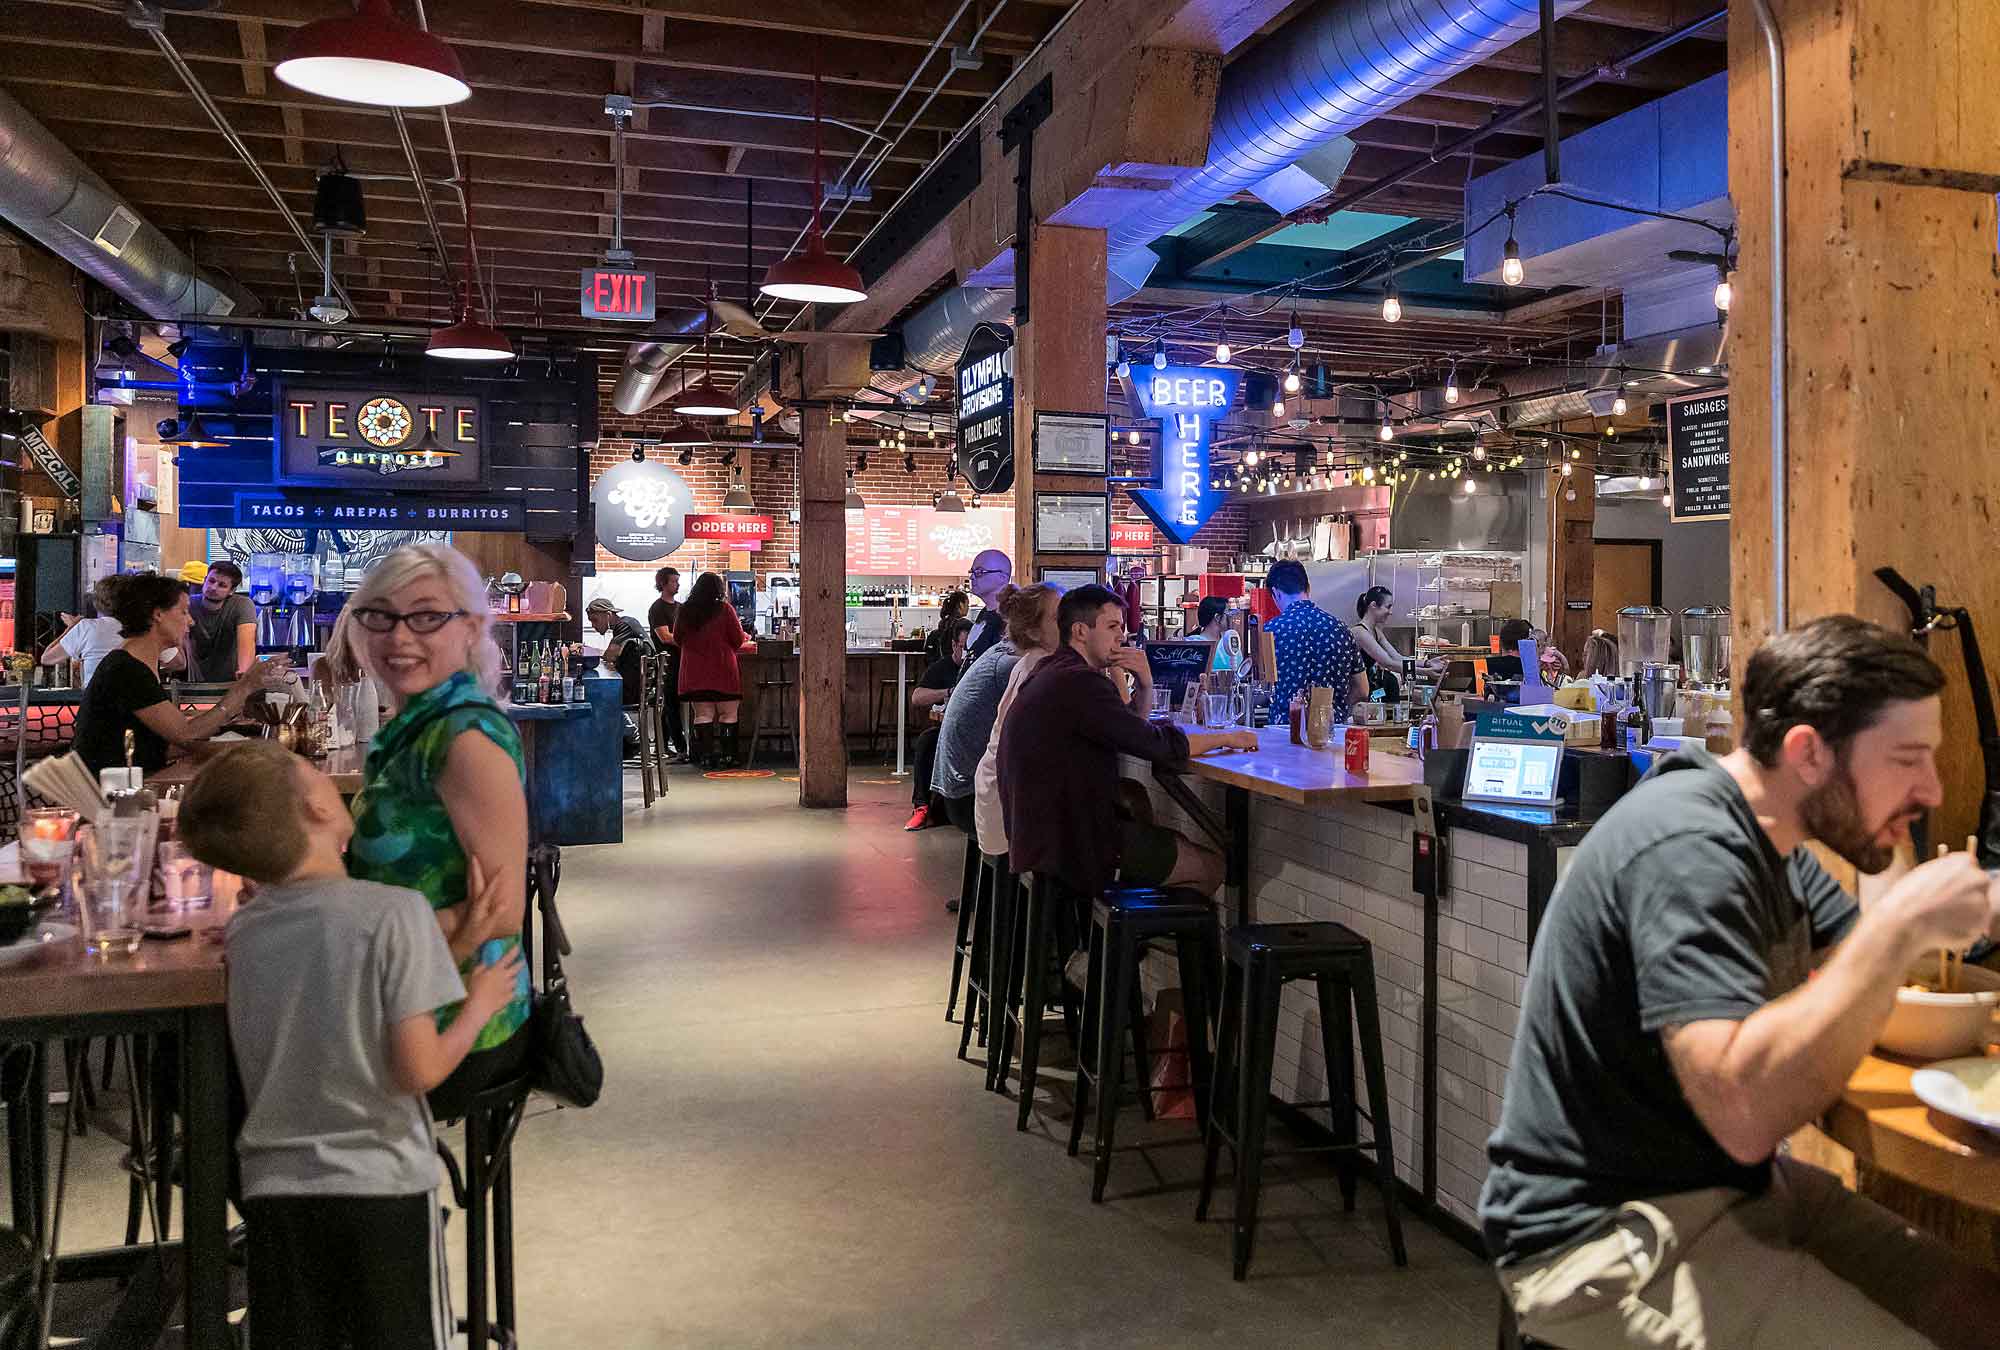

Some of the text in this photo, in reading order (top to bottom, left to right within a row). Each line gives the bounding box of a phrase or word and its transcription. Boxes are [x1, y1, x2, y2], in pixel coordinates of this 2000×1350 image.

[593, 272, 647, 313] EXIT
[961, 351, 1003, 396] OLYMPIA
[961, 382, 1003, 418] PROVISIONS
[1152, 378, 1226, 407] BEER
[1684, 400, 1726, 416] SAUSAGES
[964, 416, 1003, 449] PUBLIC HOUSE
[23, 430, 74, 490] MEZCAL
[335, 450, 434, 467] OUTPOST
[1177, 413, 1201, 525] HERE
[251, 505, 509, 519] TACOS AREPAS BURRITOS
[691, 521, 768, 533] ORDER HERE
[1125, 531, 1151, 541] HERE
[1490, 717, 1524, 727] RITUAL
